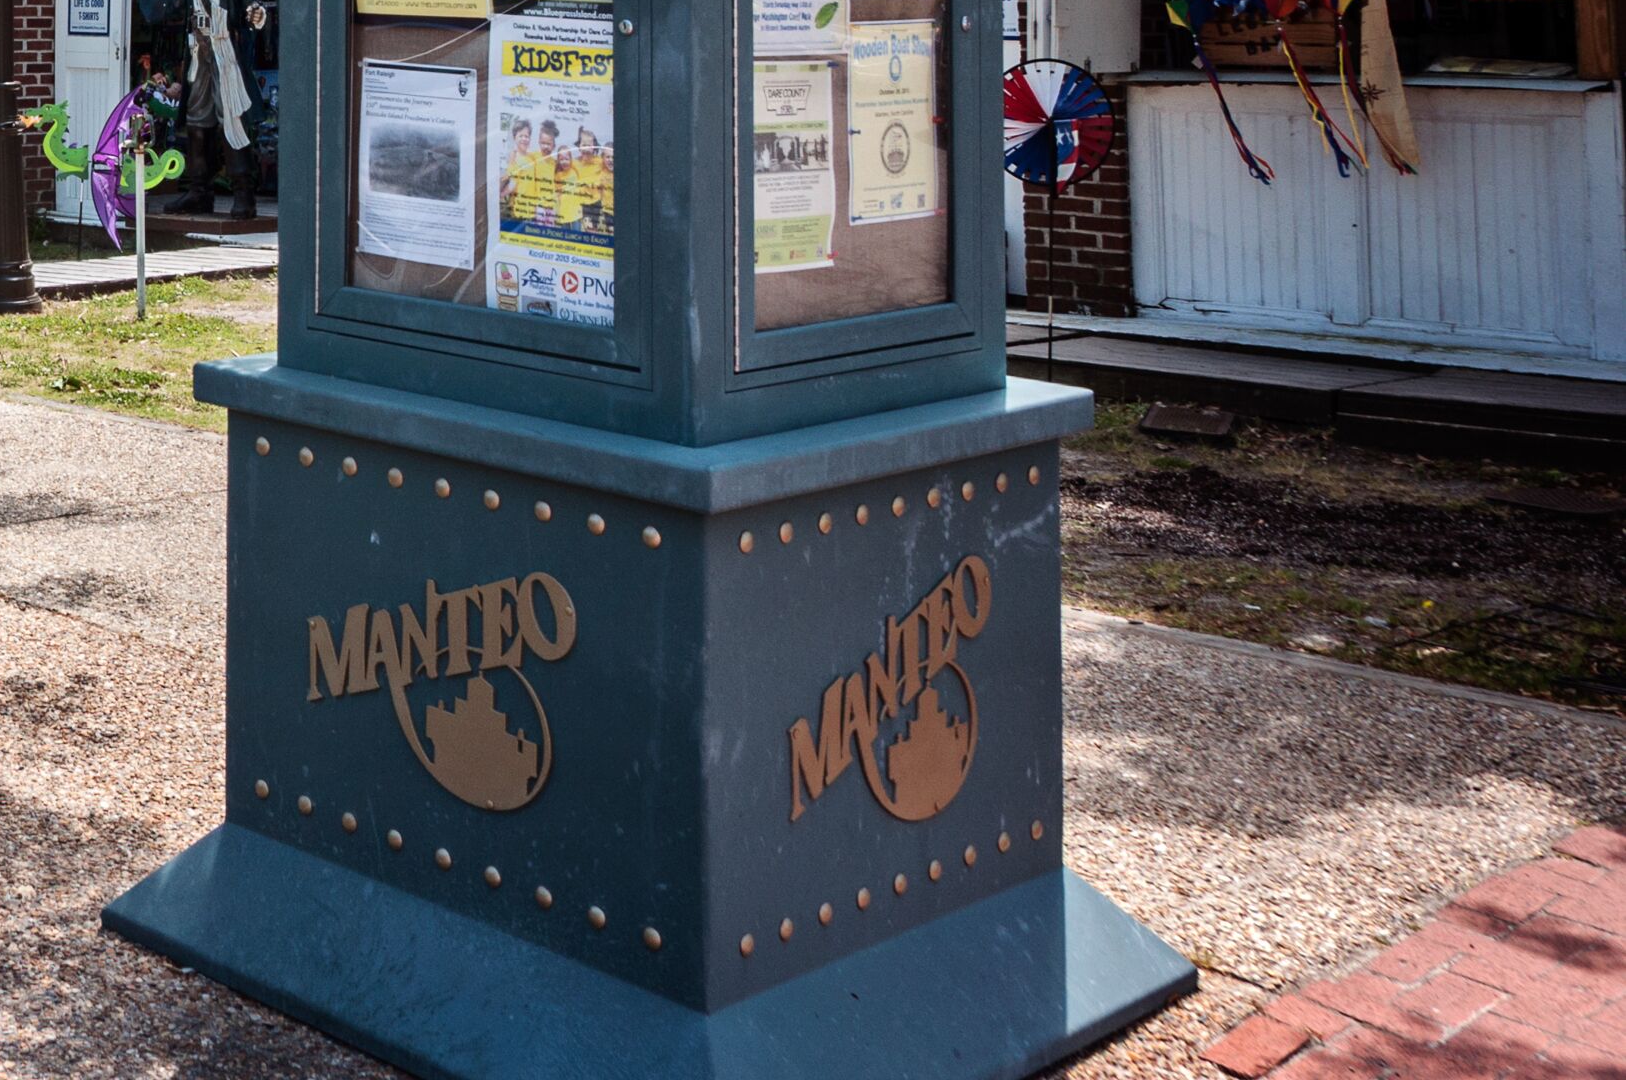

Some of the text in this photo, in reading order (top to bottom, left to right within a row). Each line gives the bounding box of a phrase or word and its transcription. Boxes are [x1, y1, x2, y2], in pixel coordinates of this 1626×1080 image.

[74, 0, 104, 8] LIFE IS GOOD
[78, 12, 100, 21] T-SHIRTS
[552, 26, 579, 35] Partnership
[853, 36, 889, 60] Wooden
[891, 34, 910, 55] Boat
[376, 70, 395, 78] Raleigh
[555, 254, 570, 262] 2013
[306, 571, 577, 702] MANTEO
[787, 555, 992, 822] MANTEO
